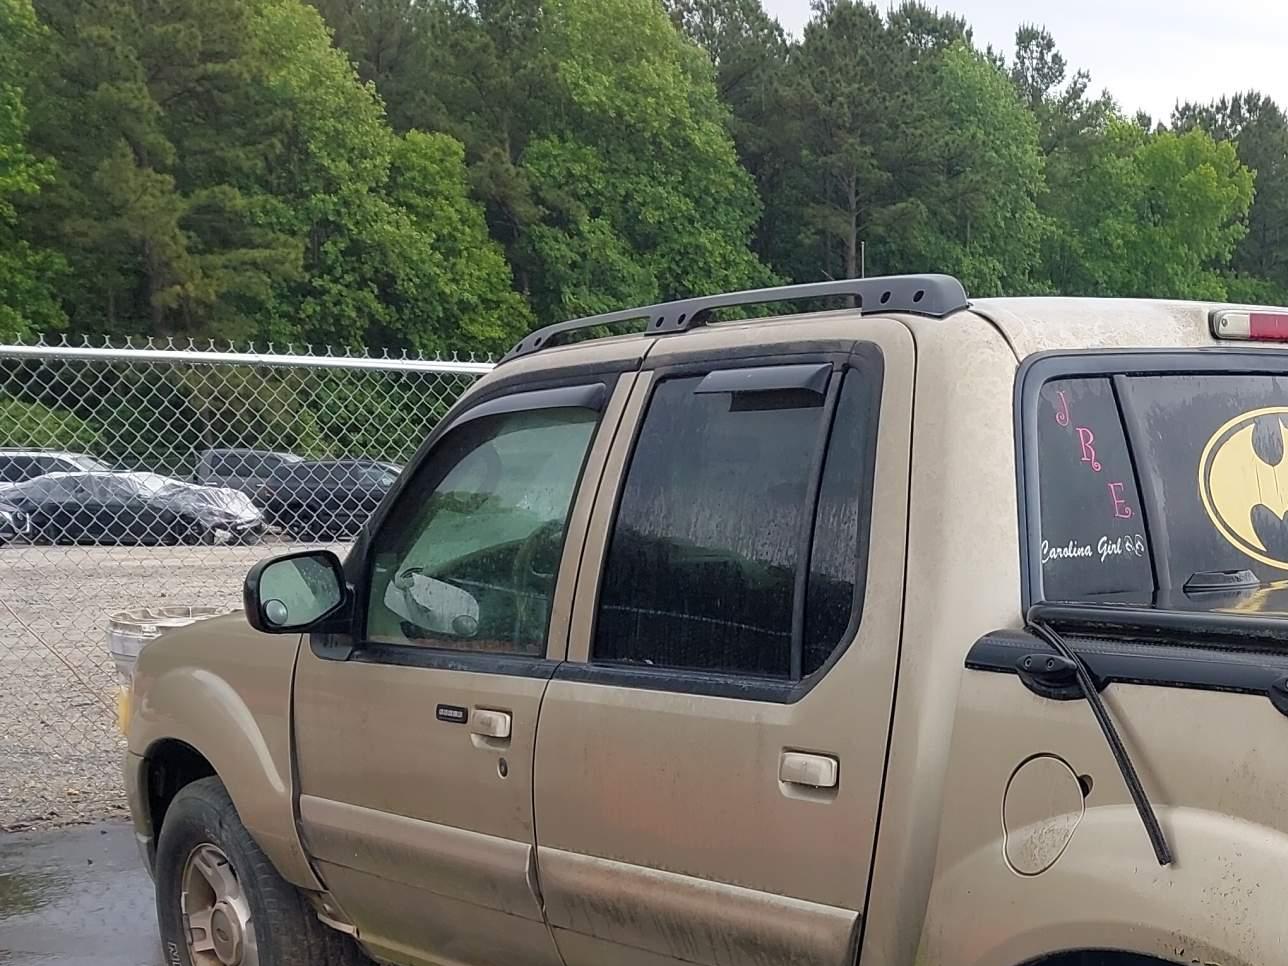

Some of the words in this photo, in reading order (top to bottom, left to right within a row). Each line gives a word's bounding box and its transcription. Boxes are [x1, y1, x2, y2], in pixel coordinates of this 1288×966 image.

[1076, 427, 1101, 471] R
[1041, 539, 1093, 564] Carolina
[1097, 536, 1122, 563] Girl
